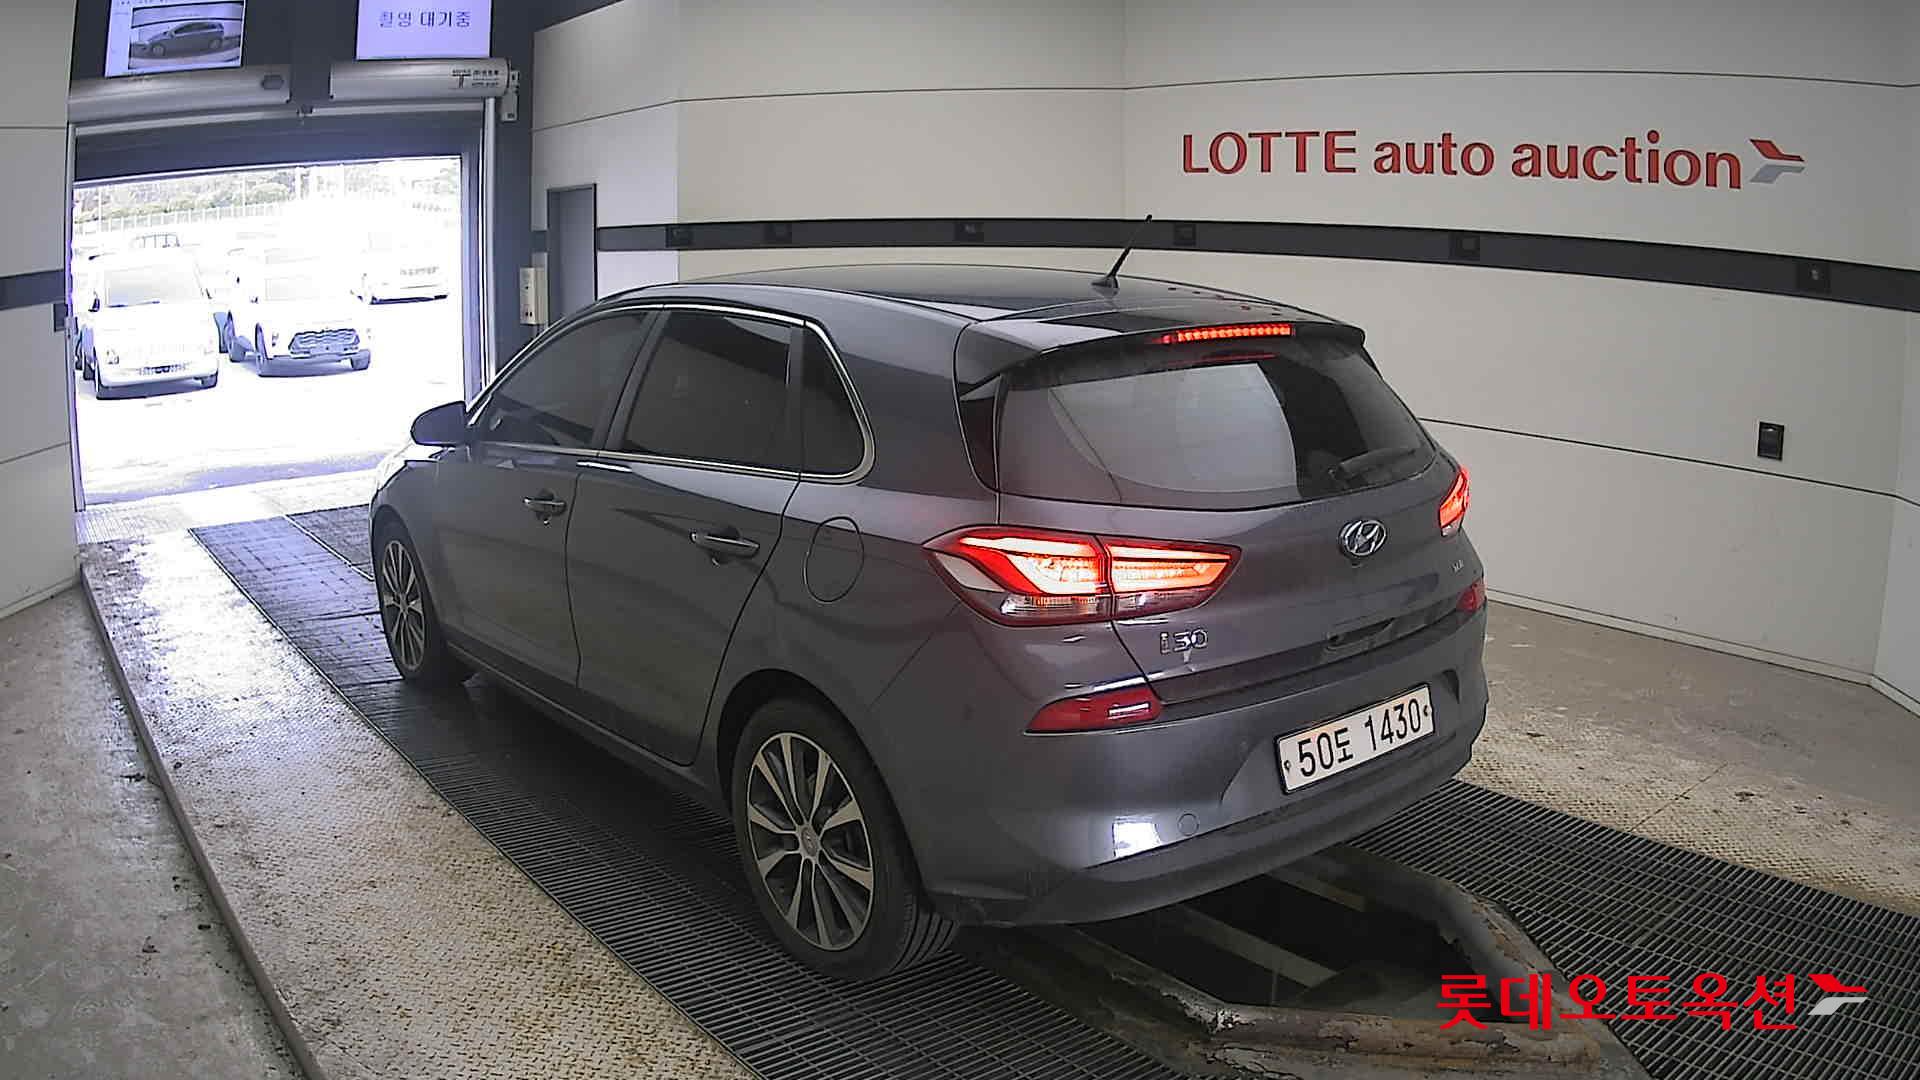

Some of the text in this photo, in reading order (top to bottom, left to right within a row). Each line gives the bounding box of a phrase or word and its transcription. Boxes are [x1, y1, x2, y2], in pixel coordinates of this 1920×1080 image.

[420, 11, 470, 28] 대기중
[1183, 130, 1742, 190] LOTTE auto auction
[1298, 698, 1421, 777] 50도 1430
